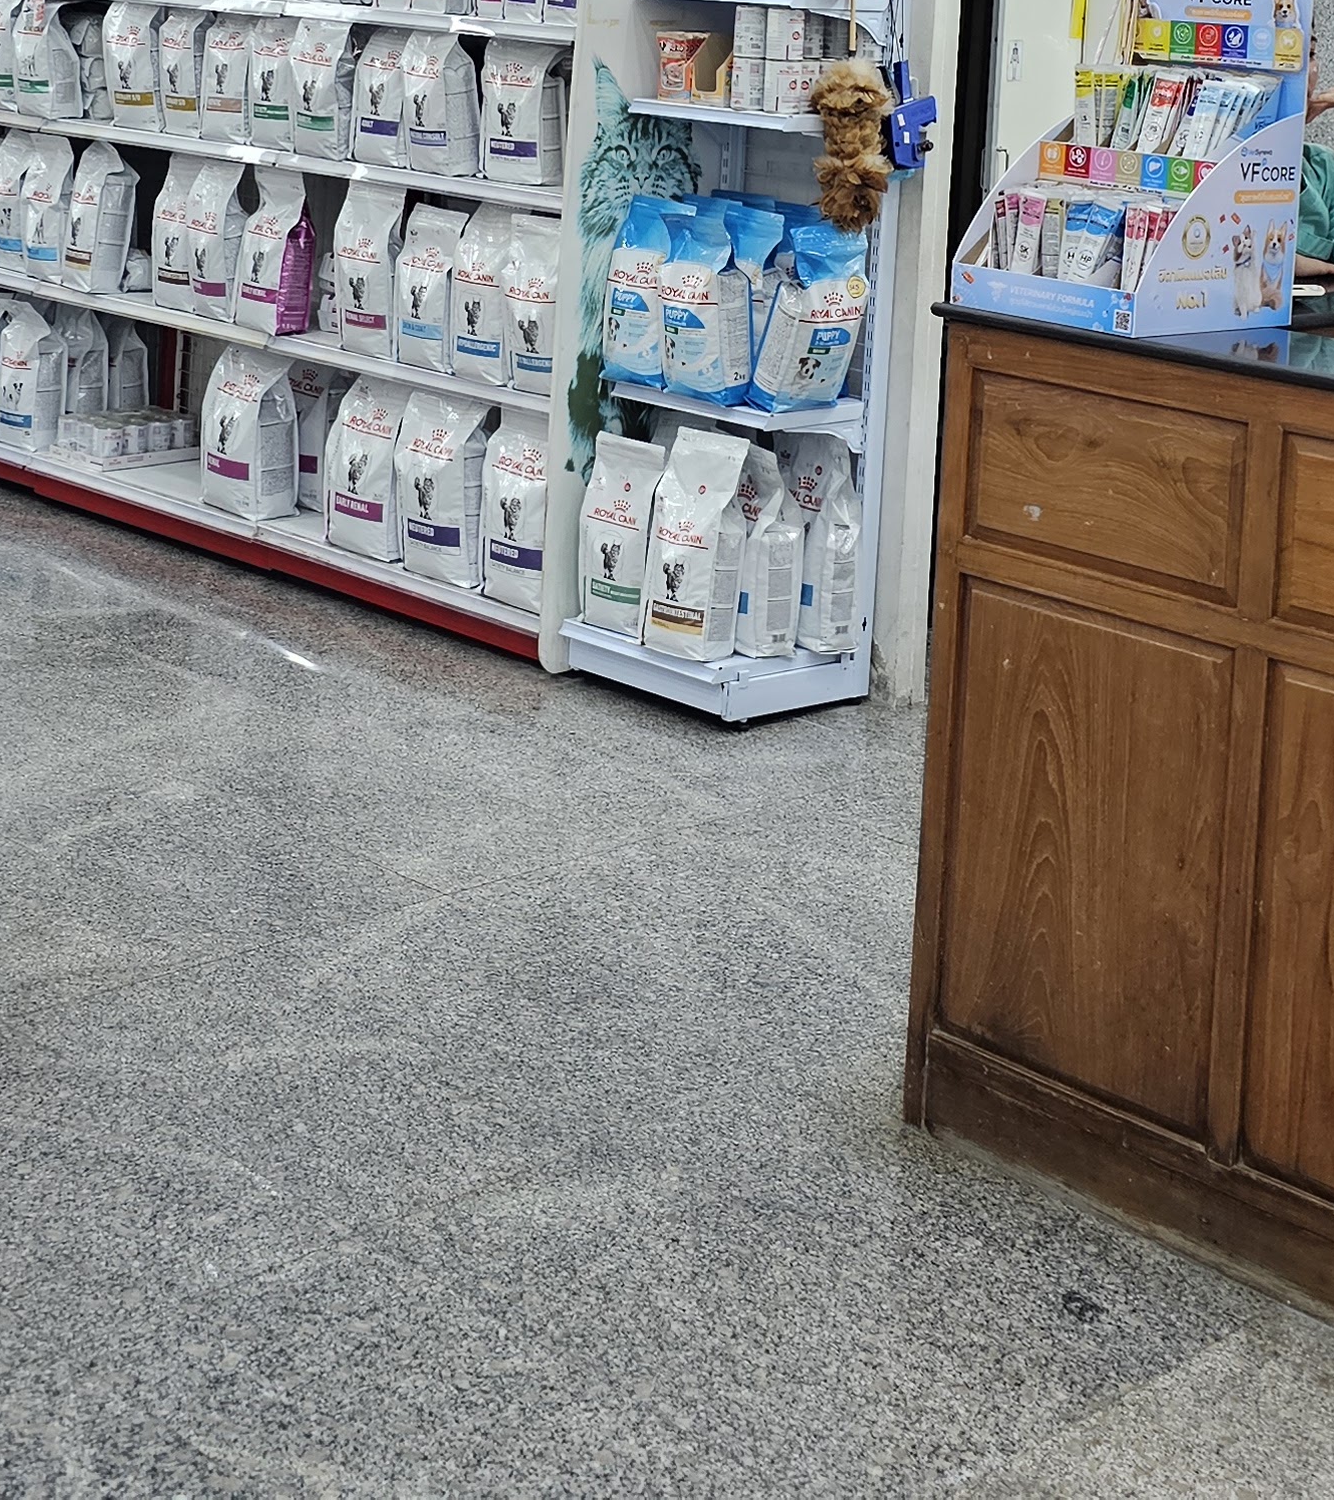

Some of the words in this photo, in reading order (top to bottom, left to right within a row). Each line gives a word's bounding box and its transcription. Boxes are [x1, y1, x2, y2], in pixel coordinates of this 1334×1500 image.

[1080, 253, 1092, 263] HP
[613, 268, 639, 284] ROYAL
[615, 290, 638, 303] PUPPY
[1010, 285, 1057, 302] VETERINARY
[1058, 293, 1095, 309] FORMULA
[665, 308, 688, 321] PUPPY
[810, 308, 833, 320] ROYAL
[835, 306, 861, 318] CANIN
[816, 330, 841, 341] PUPPY
[593, 507, 617, 523] ROYAL
[658, 525, 681, 542] ROYAL
